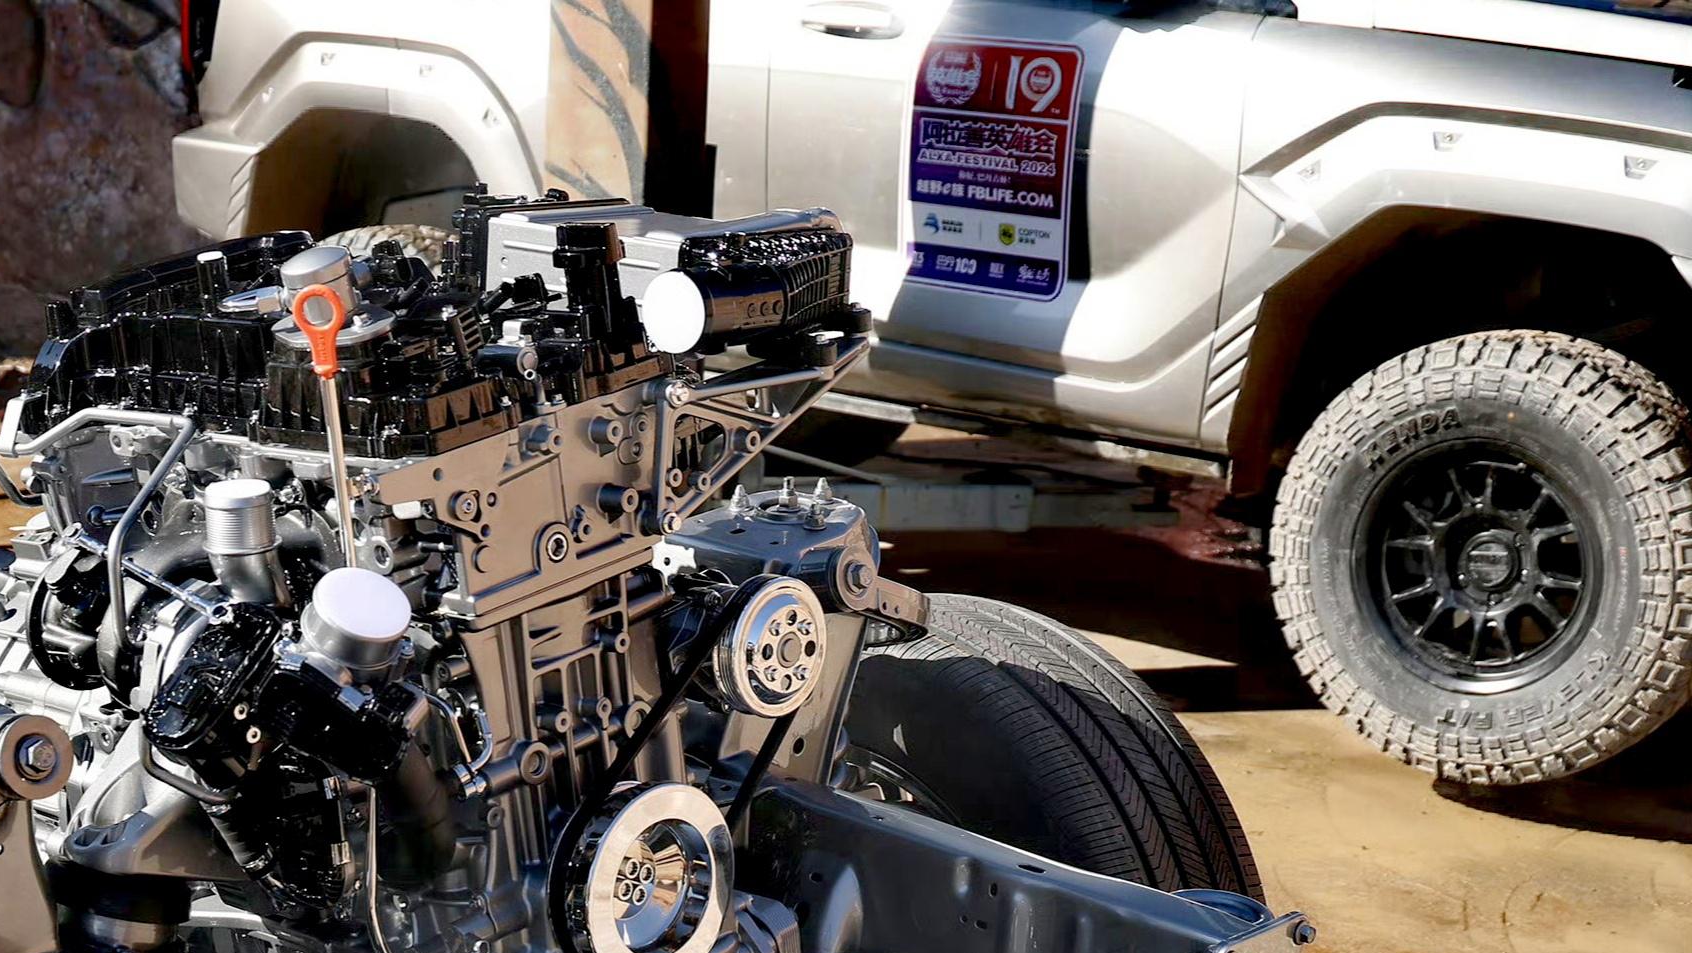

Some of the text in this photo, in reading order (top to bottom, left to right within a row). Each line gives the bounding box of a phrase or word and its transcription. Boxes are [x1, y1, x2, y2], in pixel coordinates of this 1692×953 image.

[1005, 55, 1062, 113] 19
[958, 153, 1018, 171] FESTIVAL
[1020, 160, 1057, 177] 2024
[967, 183, 1054, 208] FBLIFE.COM
[1361, 406, 1462, 472] KENDA
